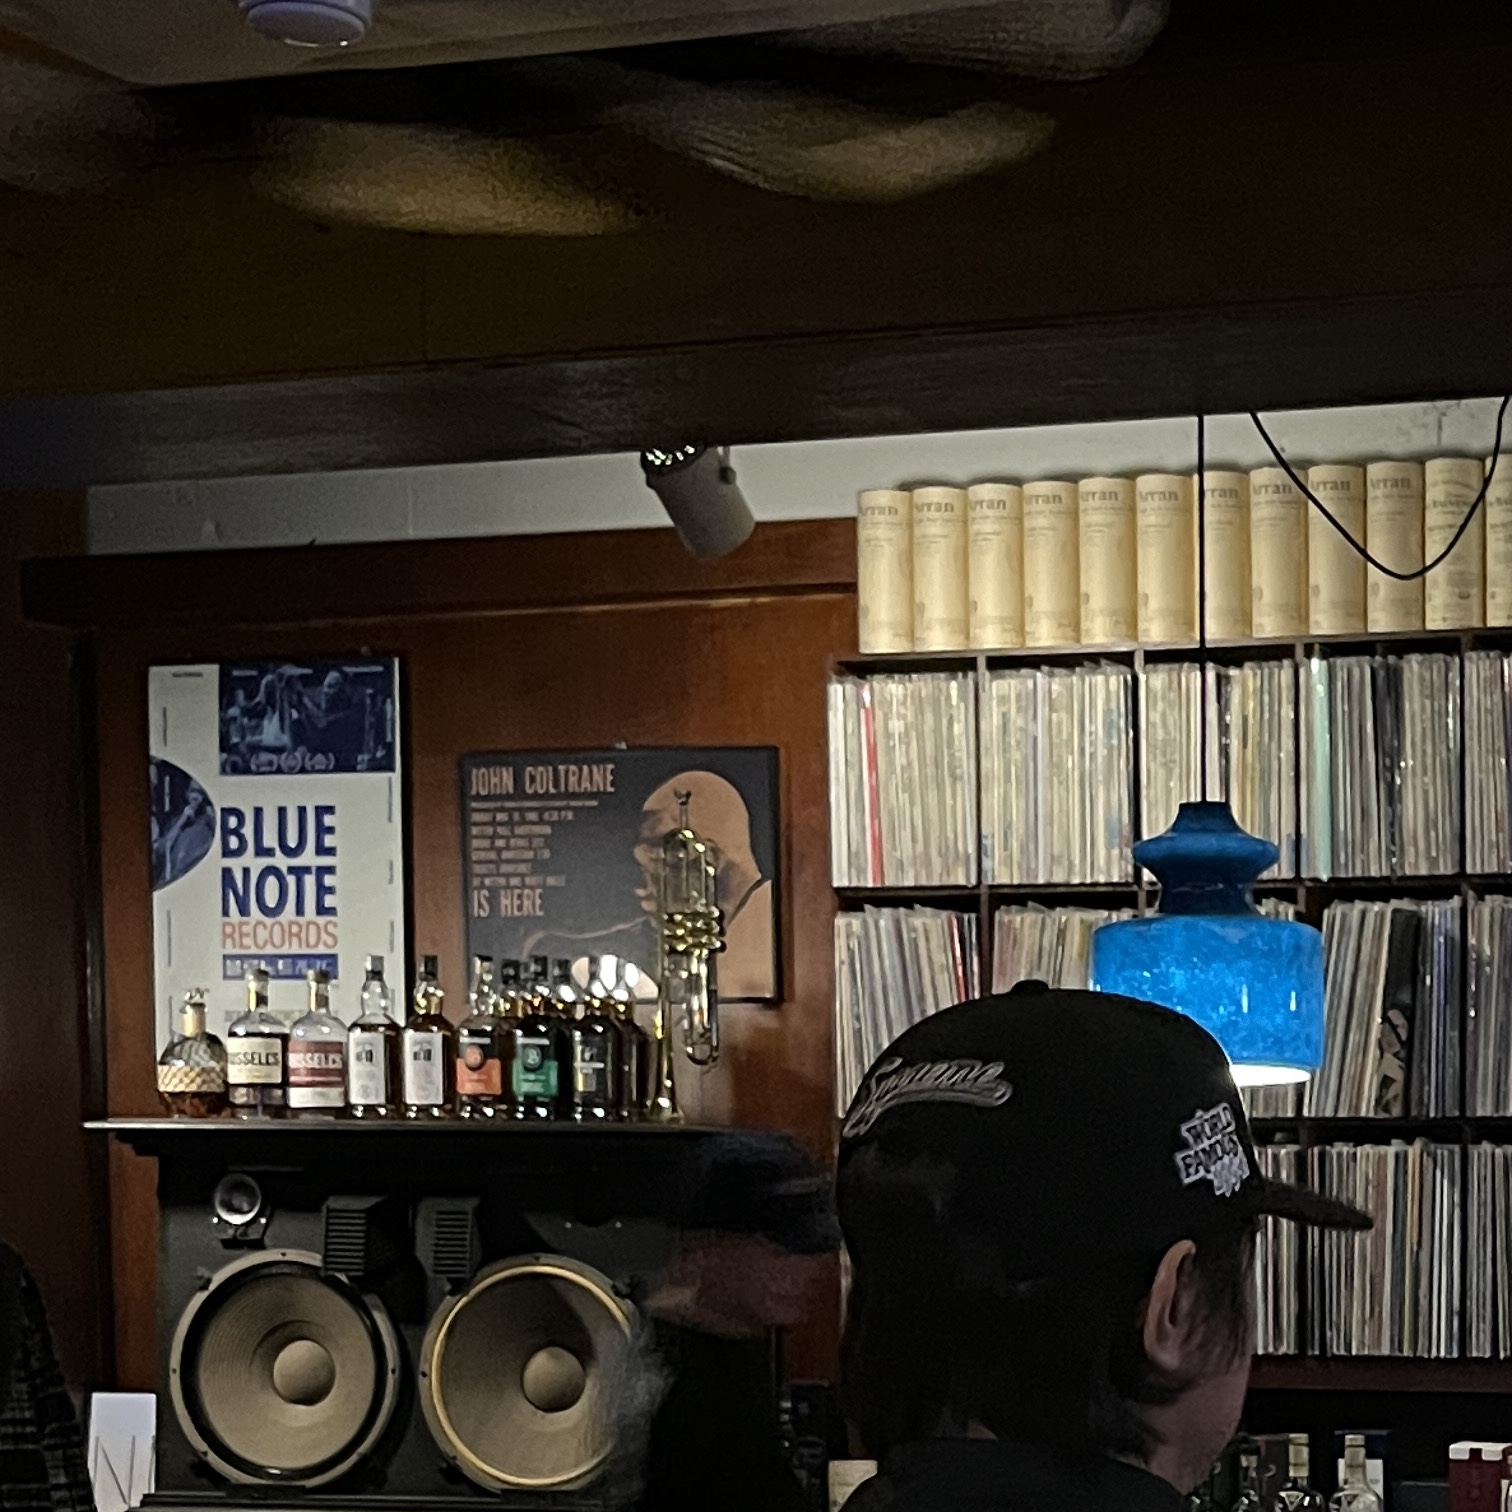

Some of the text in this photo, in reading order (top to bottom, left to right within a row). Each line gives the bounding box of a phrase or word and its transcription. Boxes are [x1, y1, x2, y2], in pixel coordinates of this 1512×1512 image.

[1205, 488, 1238, 499] rran
[472, 764, 615, 795] JOHN COLTRANE
[220, 805, 337, 858] BLUE
[221, 865, 338, 918] NOTE
[473, 888, 544, 917] IS HERE
[221, 920, 339, 950] RECORDS
